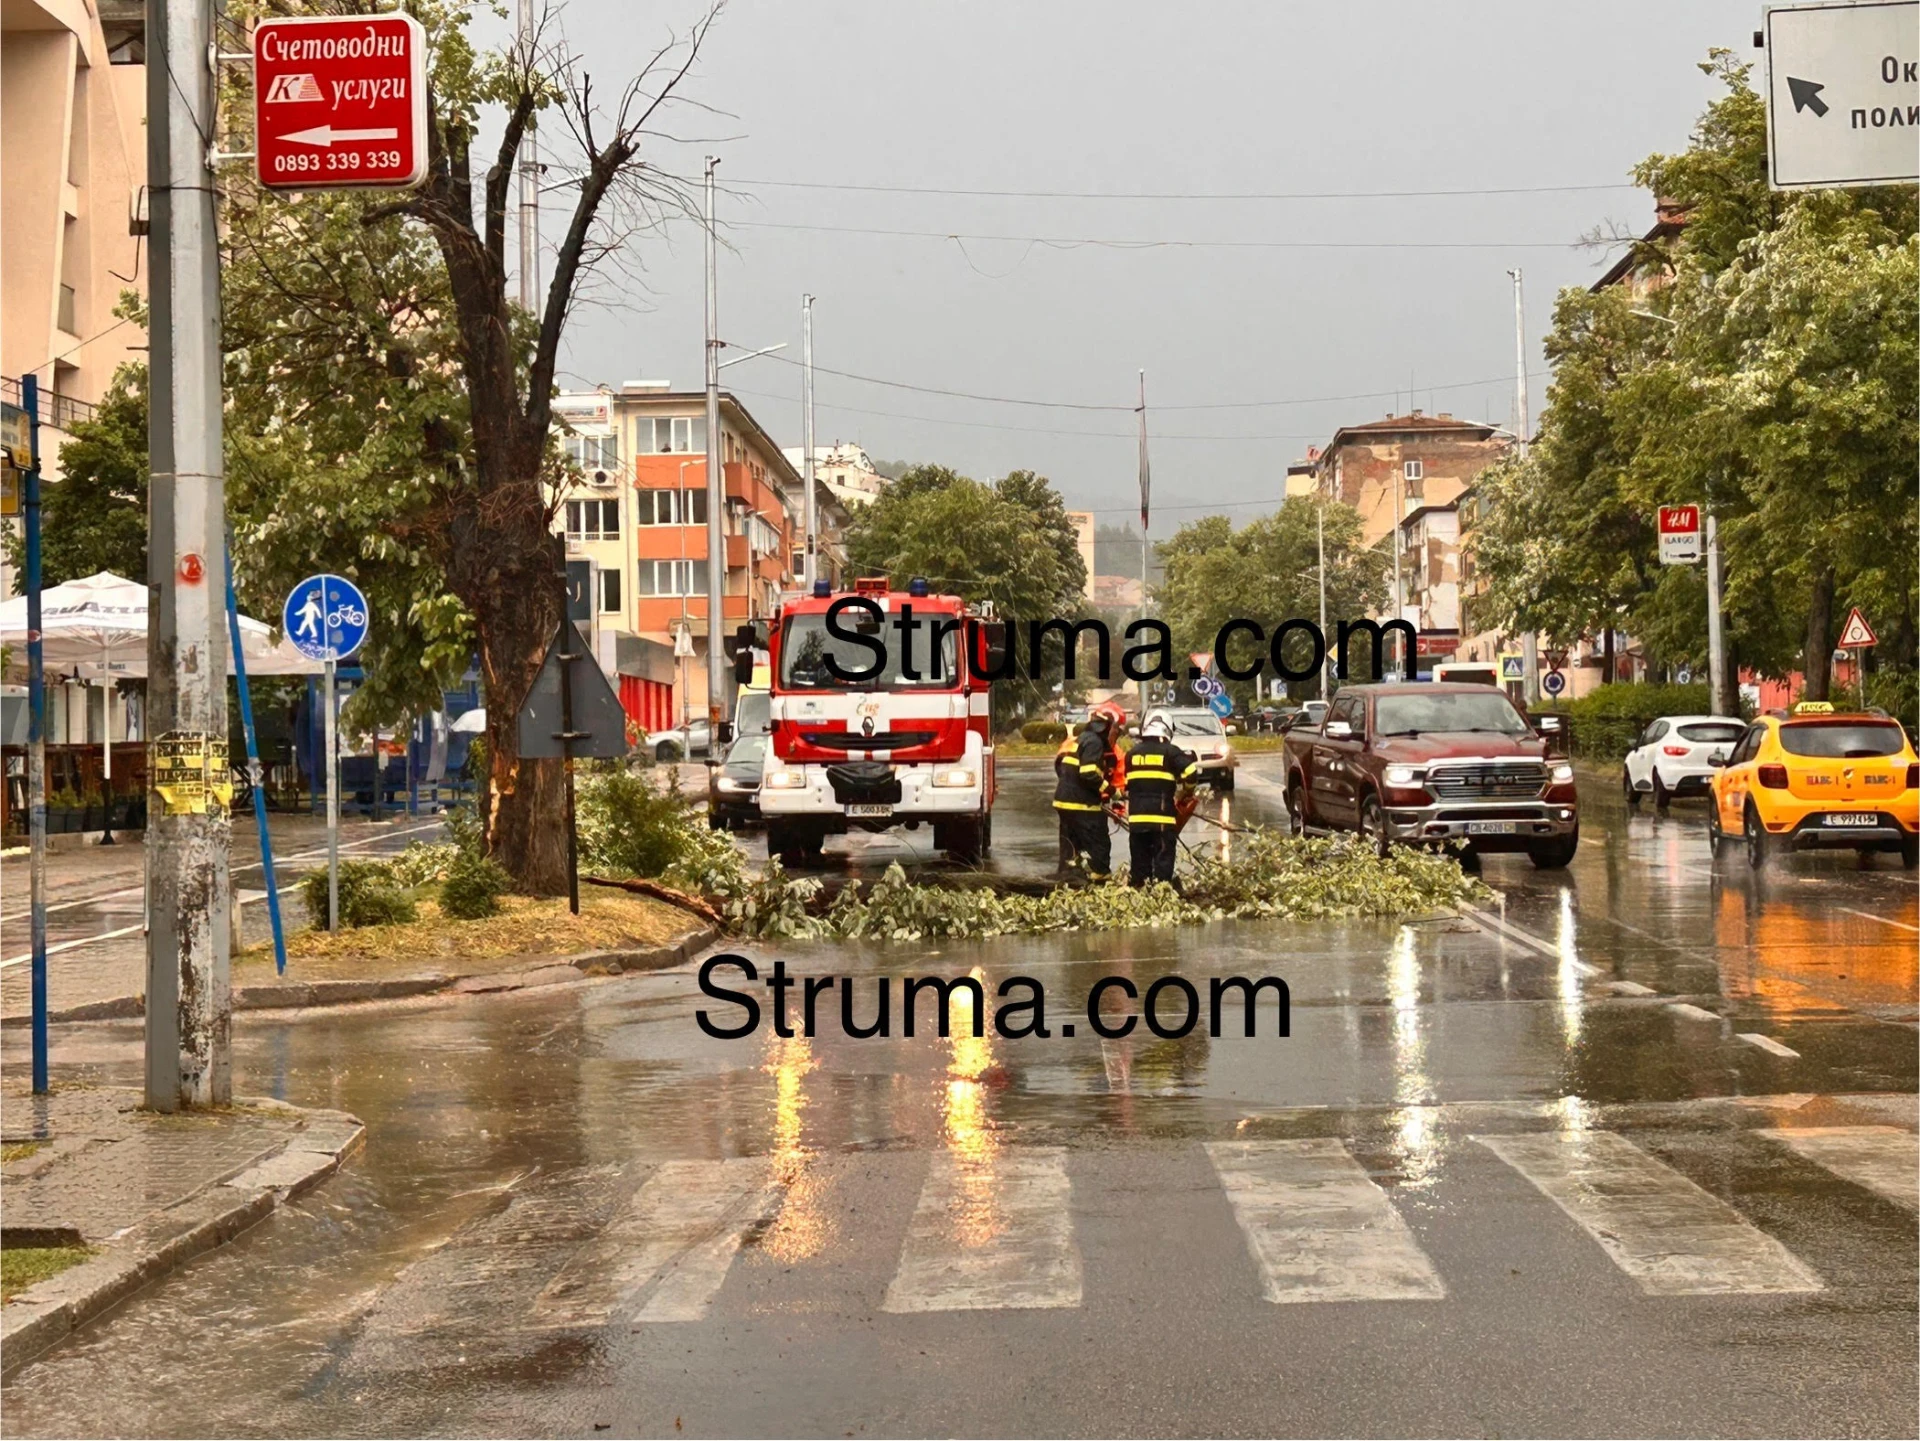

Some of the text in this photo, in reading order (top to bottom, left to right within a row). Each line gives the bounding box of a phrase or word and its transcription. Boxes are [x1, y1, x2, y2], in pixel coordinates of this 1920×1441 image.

[262, 26, 405, 62] Счетоводни
[331, 77, 406, 111] услуги
[274, 150, 401, 172] 0893 339 339
